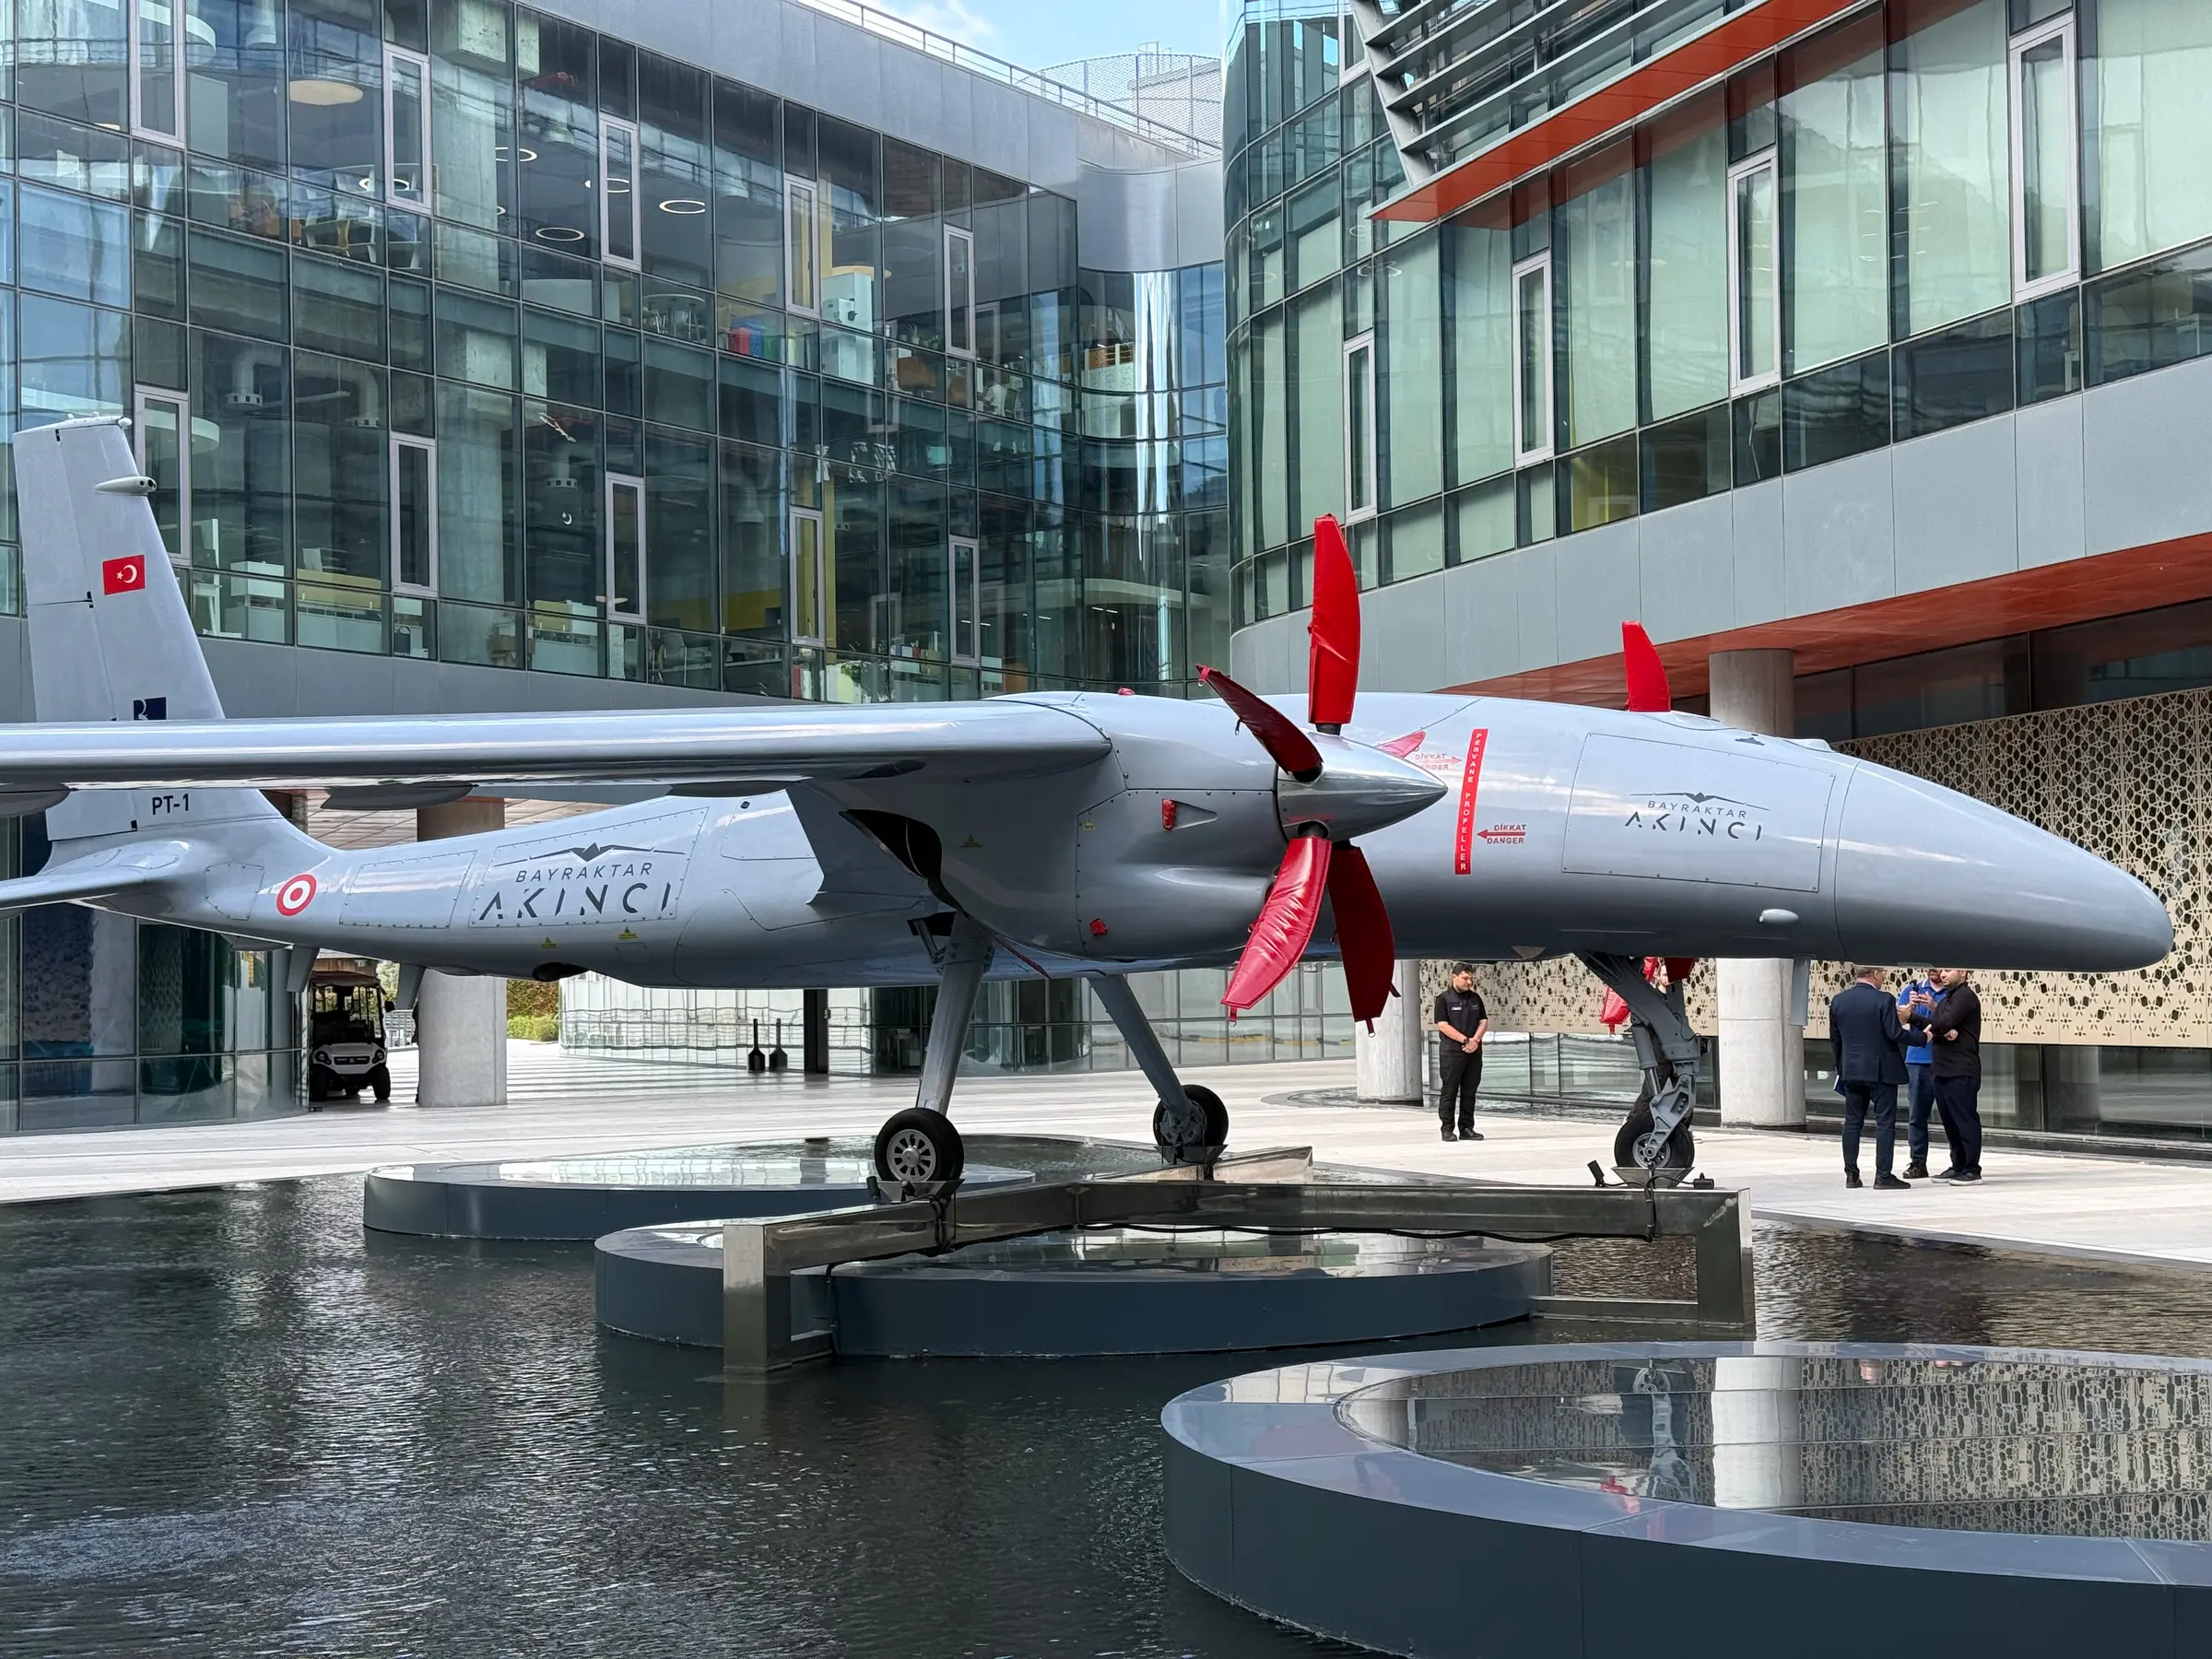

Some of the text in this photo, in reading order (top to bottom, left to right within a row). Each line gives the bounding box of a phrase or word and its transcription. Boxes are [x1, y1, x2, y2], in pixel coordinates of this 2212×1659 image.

[151, 793, 189, 816] PT-1
[1459, 733, 1482, 871] PERVANE PROPELLER
[1647, 800, 1747, 818] BAYRAKTAR
[1624, 810, 1762, 841] AKINCI
[1487, 837, 1524, 845] DANGER
[515, 862, 653, 883] BAYRAKTAR
[478, 881, 672, 921] AKINCI
